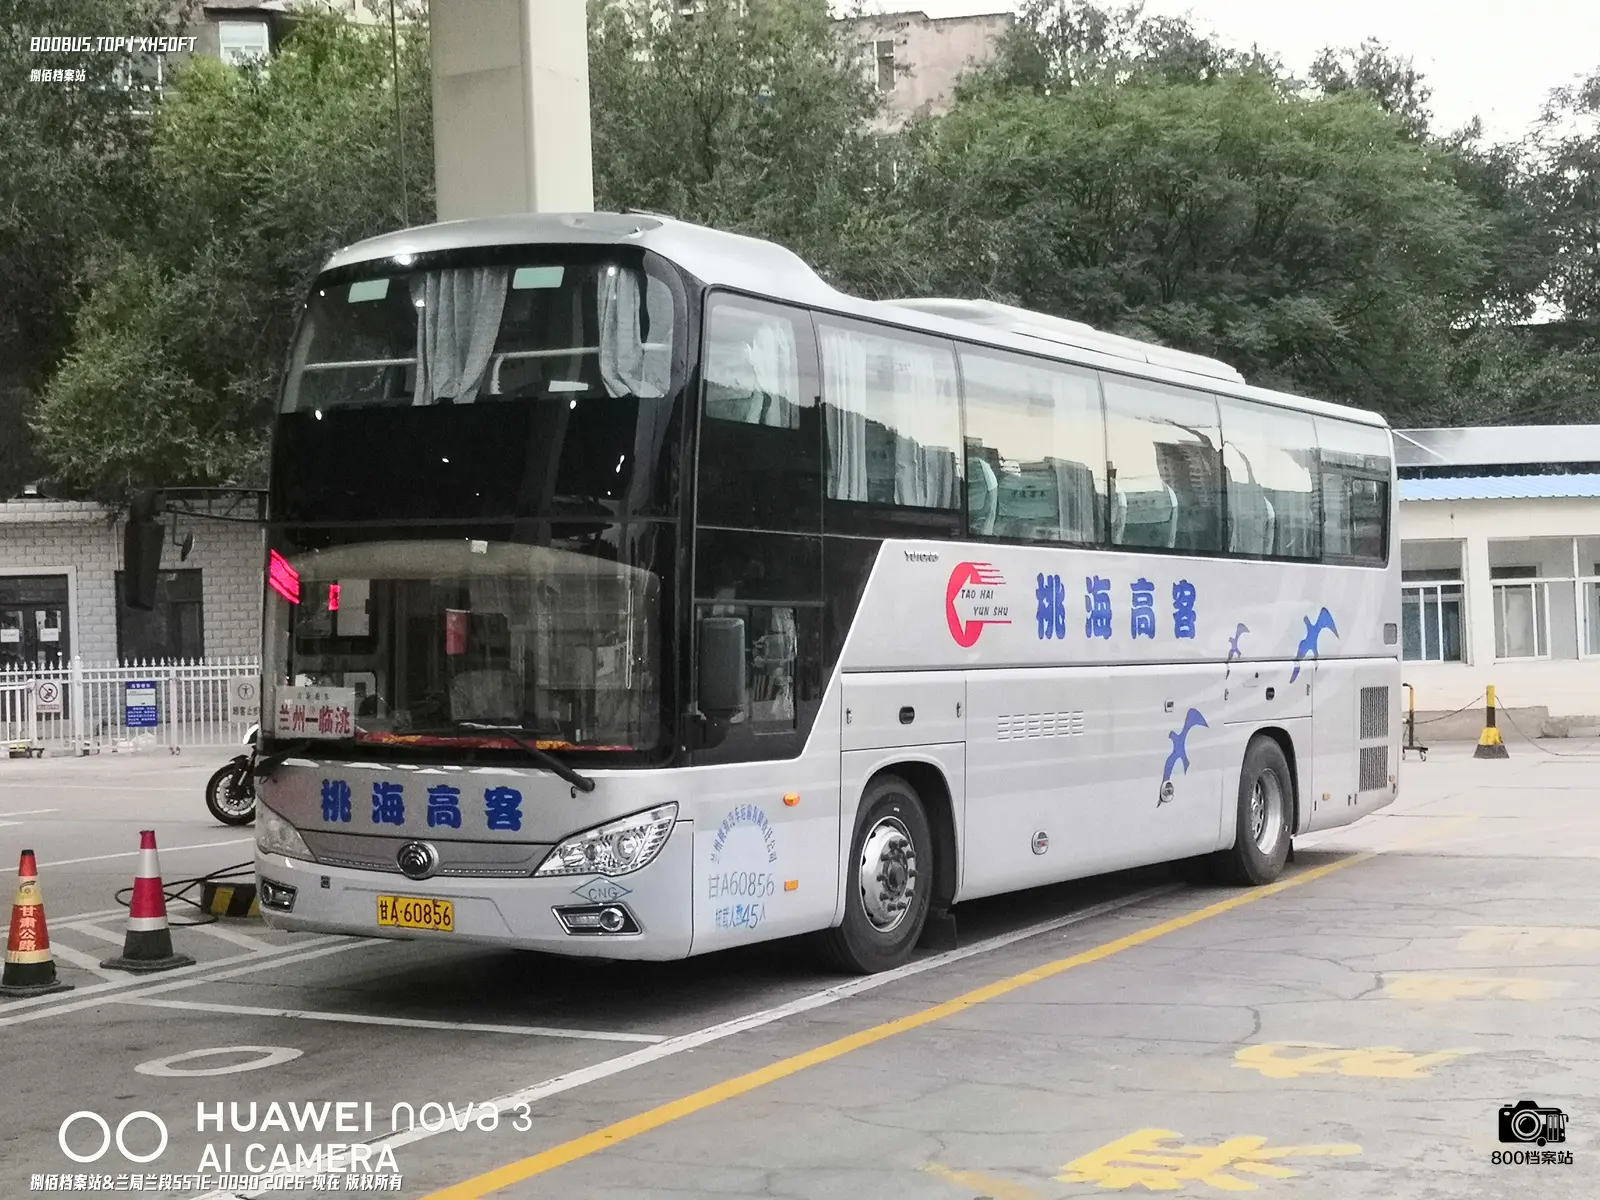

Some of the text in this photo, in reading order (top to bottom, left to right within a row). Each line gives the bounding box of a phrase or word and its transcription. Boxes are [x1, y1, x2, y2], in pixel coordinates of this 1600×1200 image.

[961, 588, 994, 600] TAO HAI
[1036, 572, 1198, 640] 桃海高客
[973, 606, 1009, 617] YUN SHU
[321, 779, 523, 832] 桃海高客
[588, 886, 619, 902] CNG
[708, 871, 775, 900] 甘A60856
[19, 905, 37, 951] 甘肃公路
